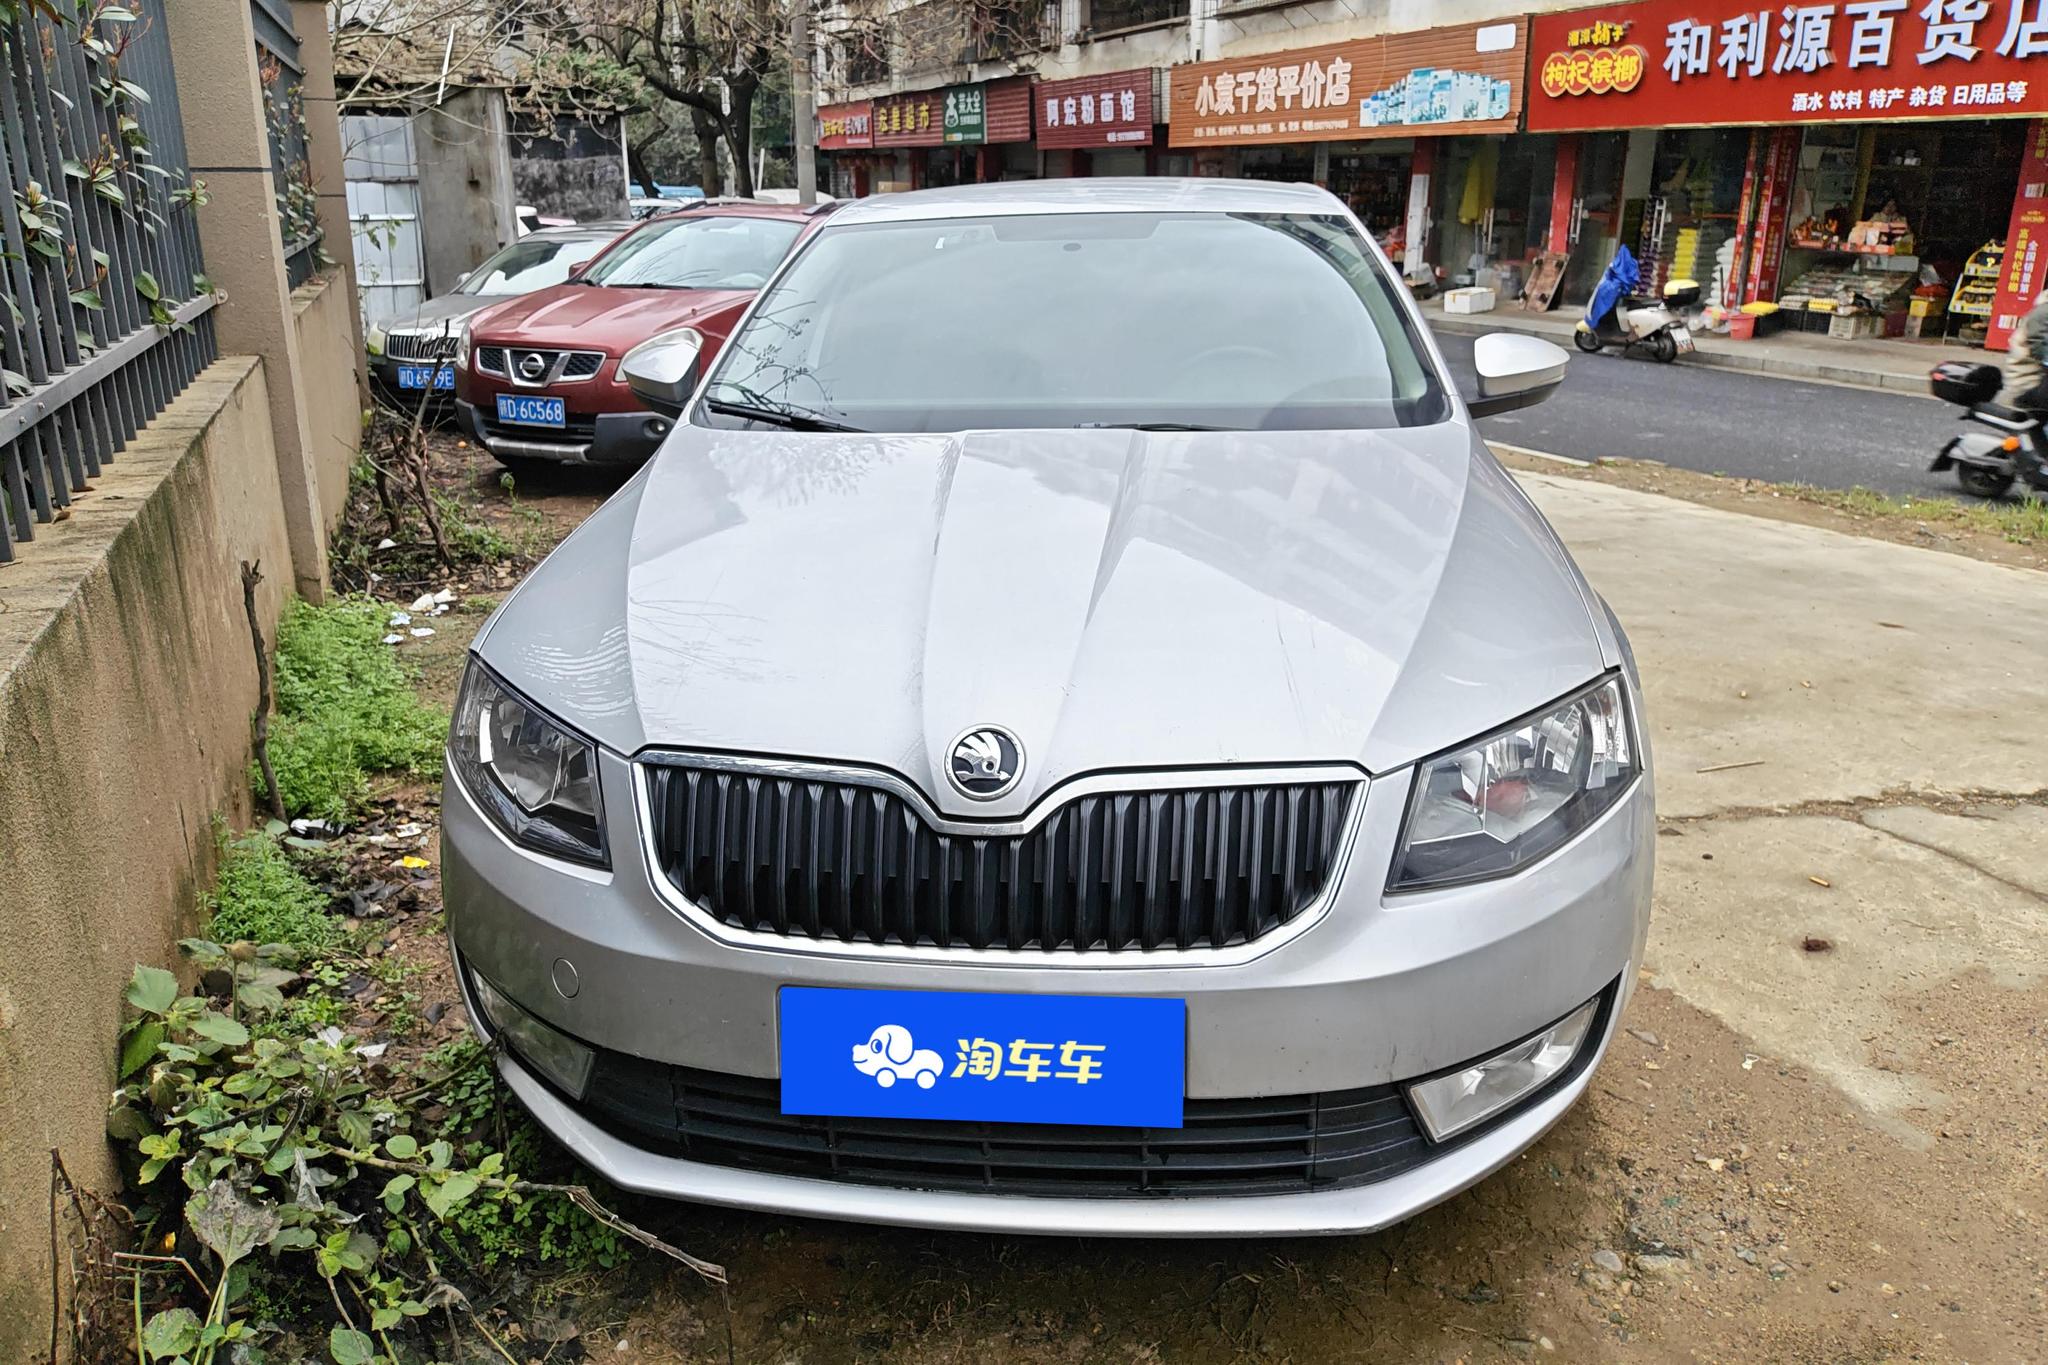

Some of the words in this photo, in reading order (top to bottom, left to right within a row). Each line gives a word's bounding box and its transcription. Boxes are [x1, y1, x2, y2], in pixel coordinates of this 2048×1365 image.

[1662, 0, 2048, 82] 和利源百货店
[1194, 56, 1353, 117] 小袁干货平价店
[1545, 54, 1640, 88] 枸杞槟榔
[1792, 92, 1824, 111] 酒水
[1828, 89, 1863, 110] 饮料
[1868, 87, 1906, 109] 特产
[1909, 85, 1948, 108] 杂货
[1952, 80, 2029, 105] 日用品等
